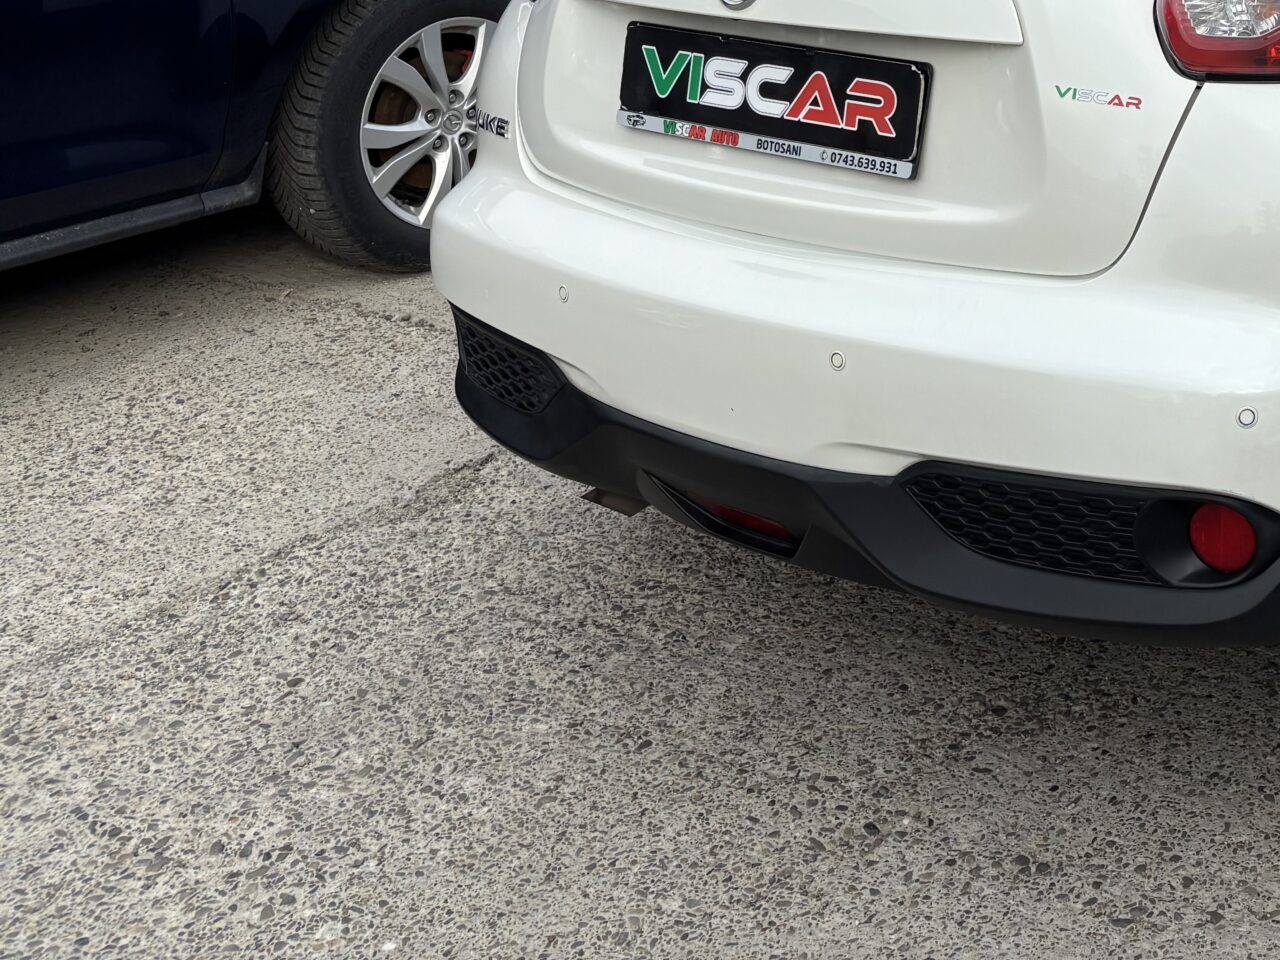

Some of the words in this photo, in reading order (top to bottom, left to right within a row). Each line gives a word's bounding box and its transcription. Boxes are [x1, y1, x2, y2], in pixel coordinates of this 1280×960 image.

[641, 45, 897, 138] VISCAR
[1055, 85, 1142, 109] VISCAR
[476, 108, 510, 139] UKE
[663, 120, 706, 140] VISCAR
[710, 129, 740, 147] AUTO
[756, 138, 802, 157] BOTOSANI
[830, 151, 898, 174] 0743.639.931
